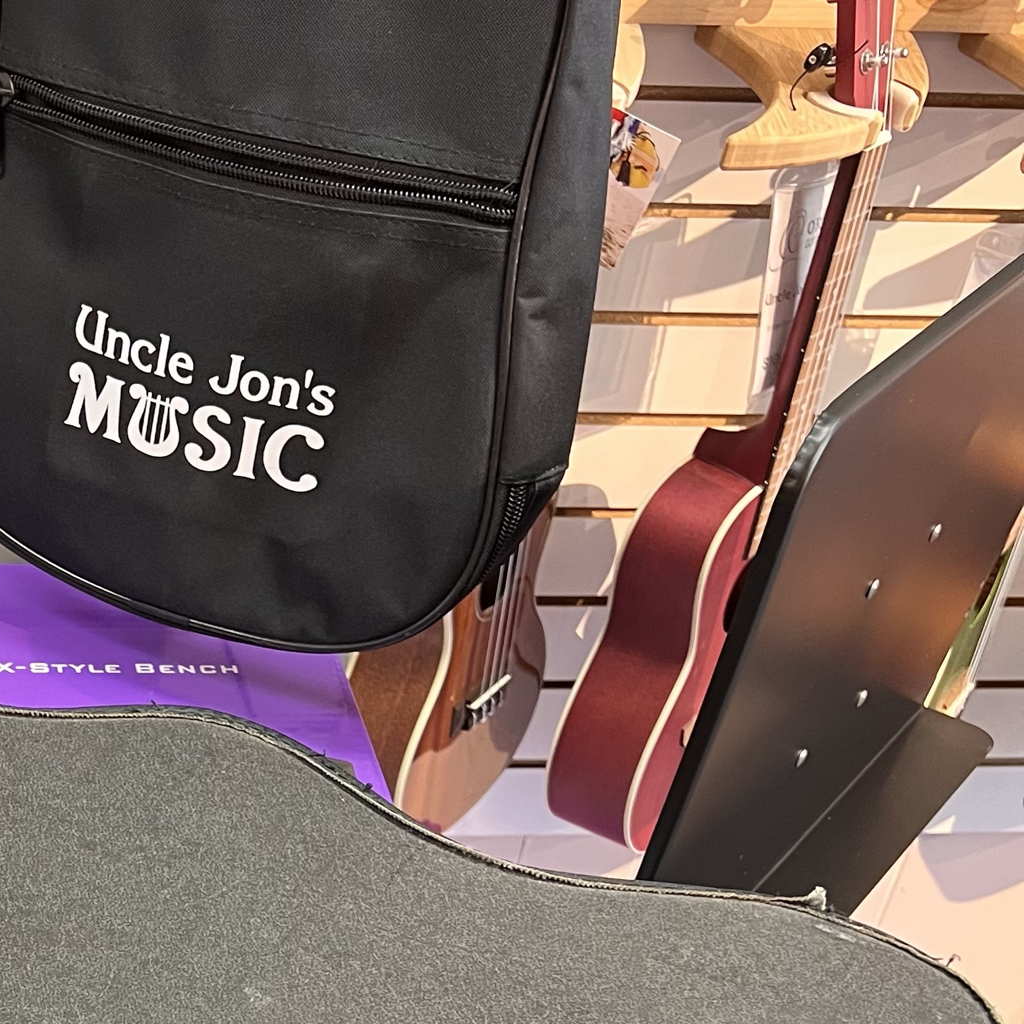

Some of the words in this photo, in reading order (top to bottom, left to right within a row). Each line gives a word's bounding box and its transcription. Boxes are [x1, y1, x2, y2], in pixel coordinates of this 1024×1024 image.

[75, 303, 194, 384] Uncle
[208, 354, 337, 417] Jon's
[64, 361, 325, 492] MUSIC
[135, 663, 239, 675] BENCH
